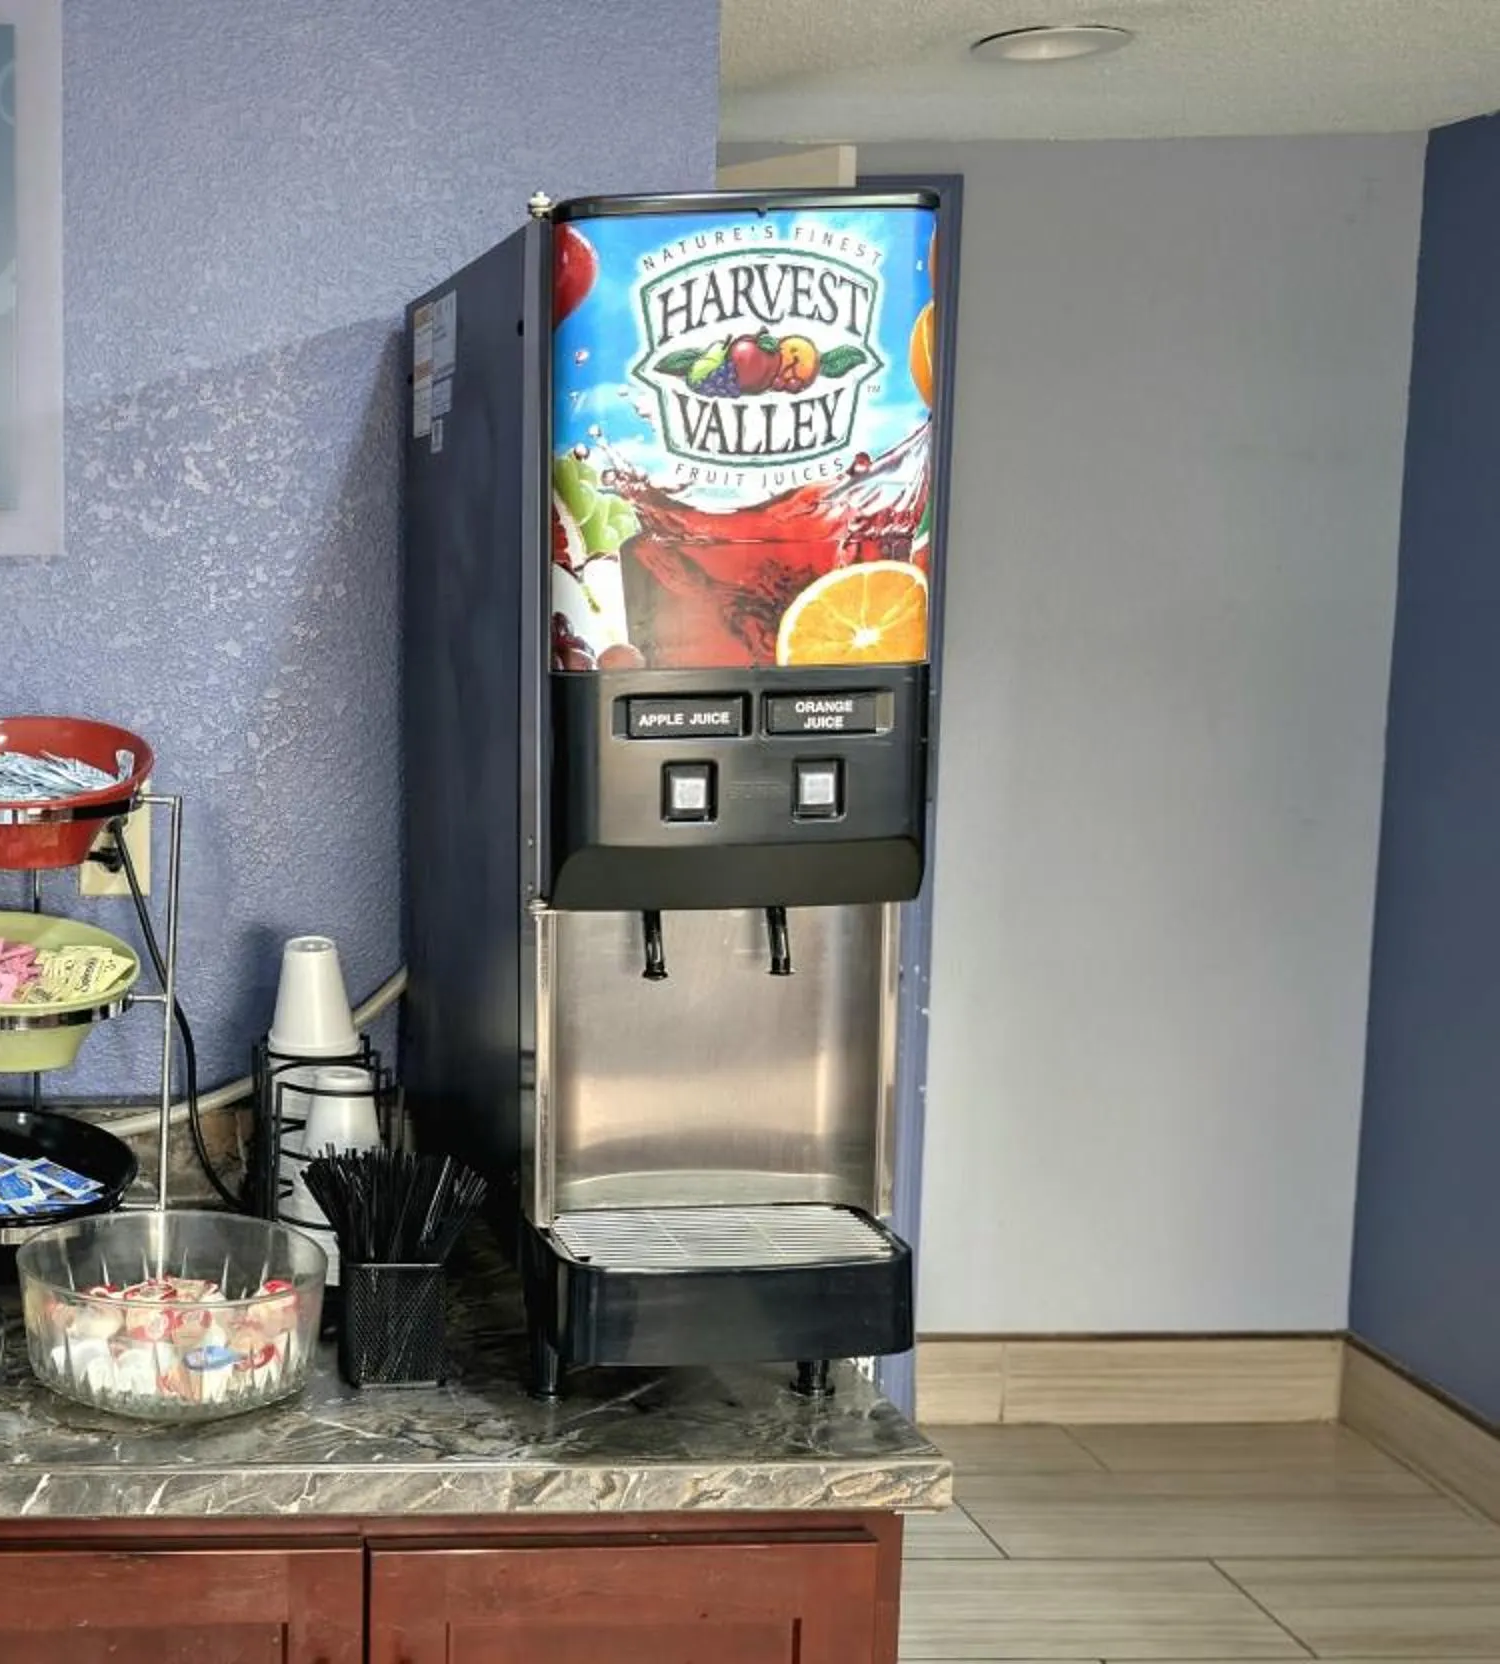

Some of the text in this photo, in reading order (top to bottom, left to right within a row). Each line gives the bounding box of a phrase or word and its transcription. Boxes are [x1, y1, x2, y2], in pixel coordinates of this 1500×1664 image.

[643, 225, 883, 271] NATURE'S FINEST
[656, 262, 869, 346] HARVEST
[670, 387, 845, 455] VALLEY
[675, 457, 844, 489] FRUIT JUICES
[639, 712, 731, 727] APPLE JUICE
[795, 701, 853, 714] ORANGE
[804, 716, 844, 729] JUICE
